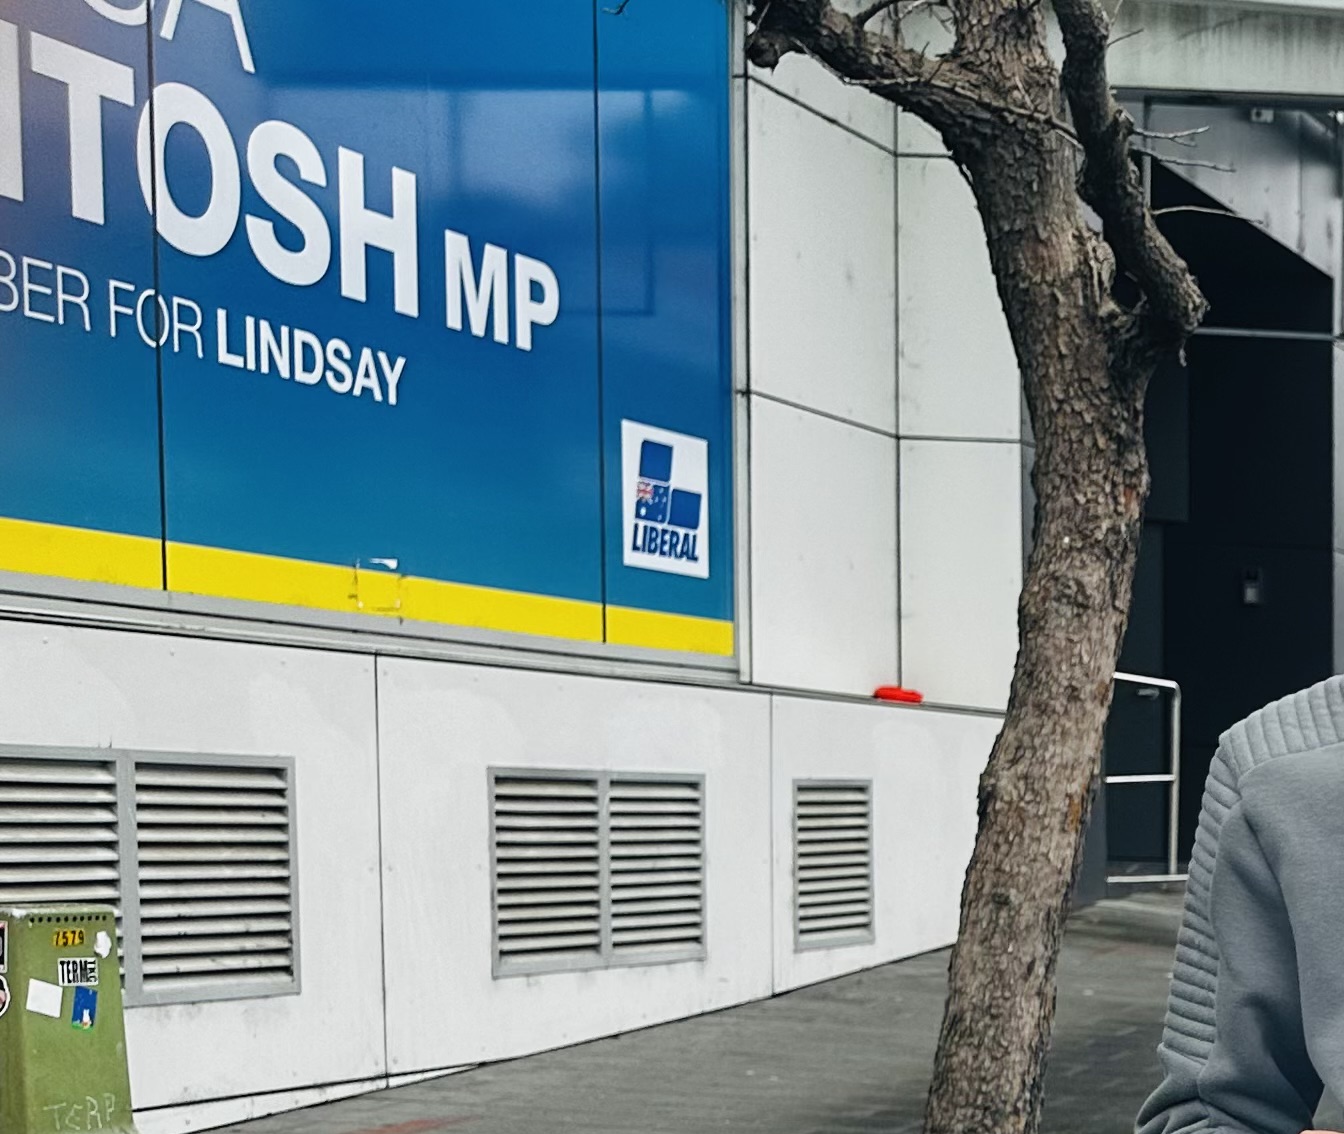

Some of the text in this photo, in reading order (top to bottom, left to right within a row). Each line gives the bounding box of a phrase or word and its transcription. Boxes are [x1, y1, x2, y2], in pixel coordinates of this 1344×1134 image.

[0, 18, 560, 352] TOSH MP
[108, 278, 204, 359] FOR
[216, 308, 407, 406] LINDSAY
[632, 523, 699, 562] LIBERAL
